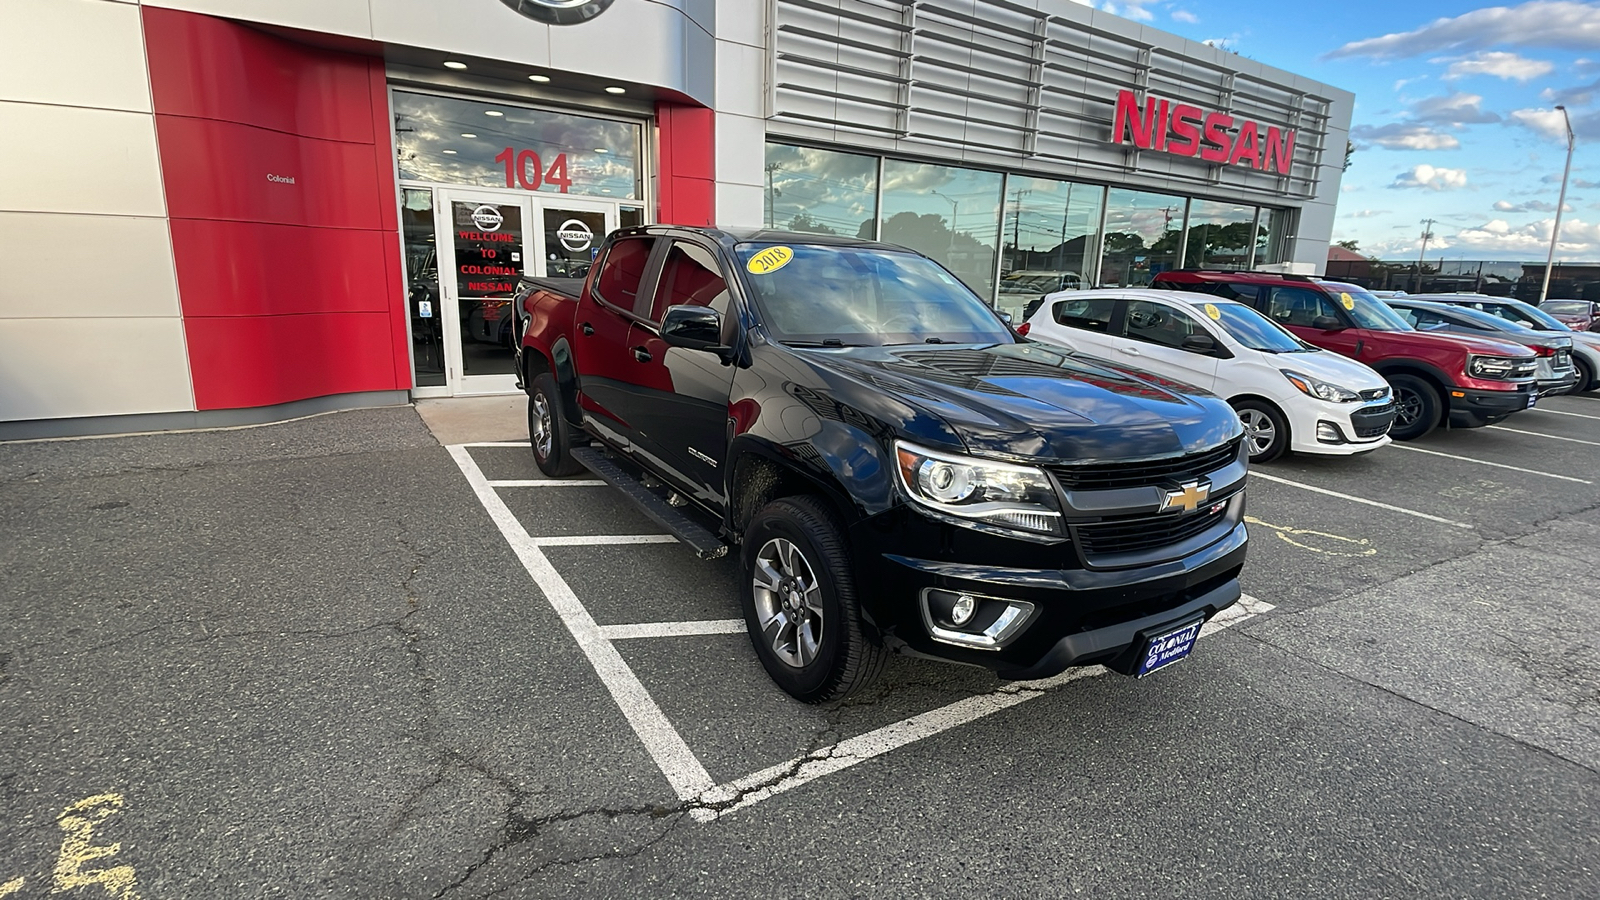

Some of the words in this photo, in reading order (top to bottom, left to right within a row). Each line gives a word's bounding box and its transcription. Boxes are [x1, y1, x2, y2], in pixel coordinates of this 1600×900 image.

[1113, 89, 1295, 175] NISSAN
[495, 147, 572, 193] 104
[266, 173, 295, 184] Colonial
[459, 231, 514, 242] WELCOME
[560, 232, 591, 240] NISSAN
[481, 249, 496, 258] TO
[756, 248, 787, 271] 2018
[460, 265, 518, 276] COLONIAL
[468, 281, 512, 292] NISSAN
